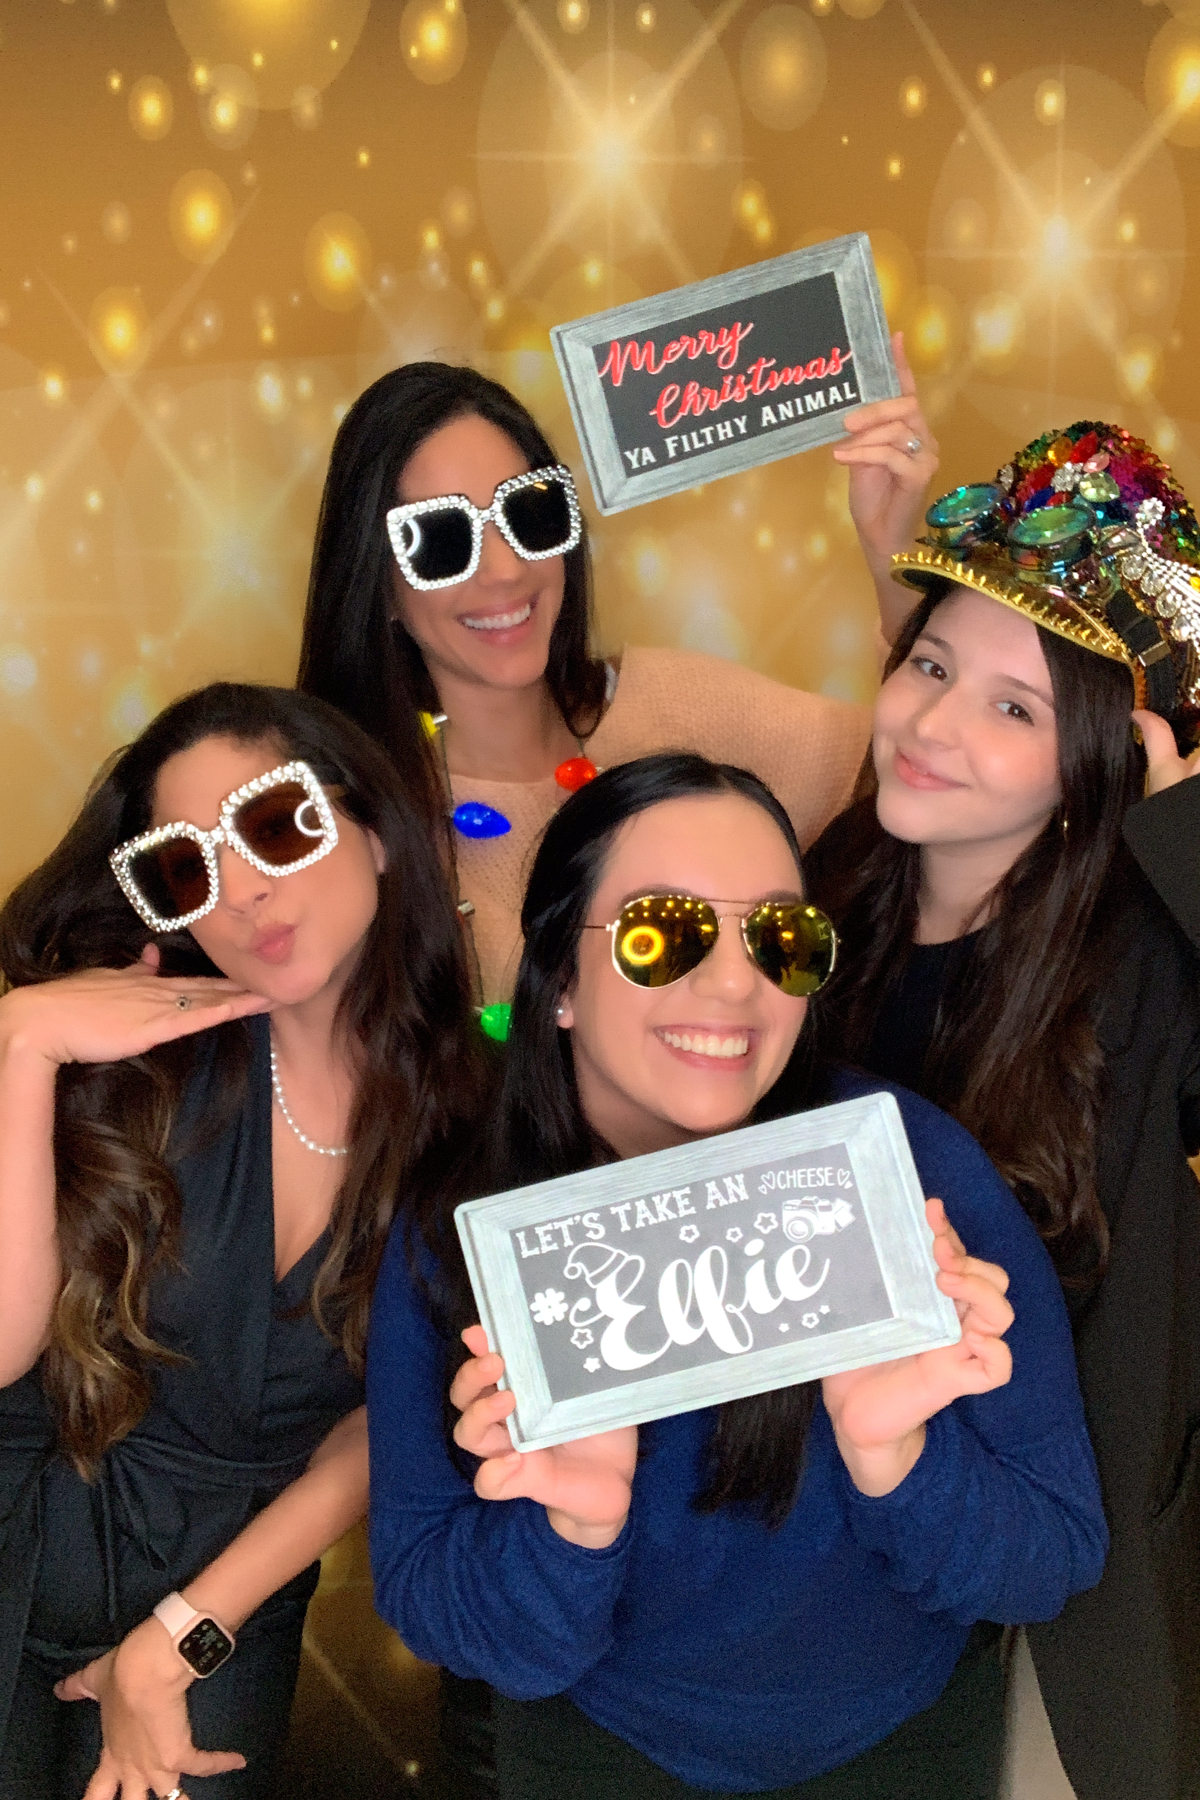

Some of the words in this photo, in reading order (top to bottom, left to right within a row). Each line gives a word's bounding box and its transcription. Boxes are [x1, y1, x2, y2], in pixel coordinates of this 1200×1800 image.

[598, 321, 754, 387] Merry
[649, 347, 854, 429] Christmas
[623, 445, 657, 470] YA
[664, 415, 749, 459] FILTHY
[760, 381, 857, 427] ANIMAL
[515, 1213, 606, 1259] LET'S
[610, 1186, 697, 1232] TAKE
[705, 1173, 749, 1210] AN
[776, 1167, 835, 1190] CHEESE
[569, 1238, 830, 1371] Elfie
